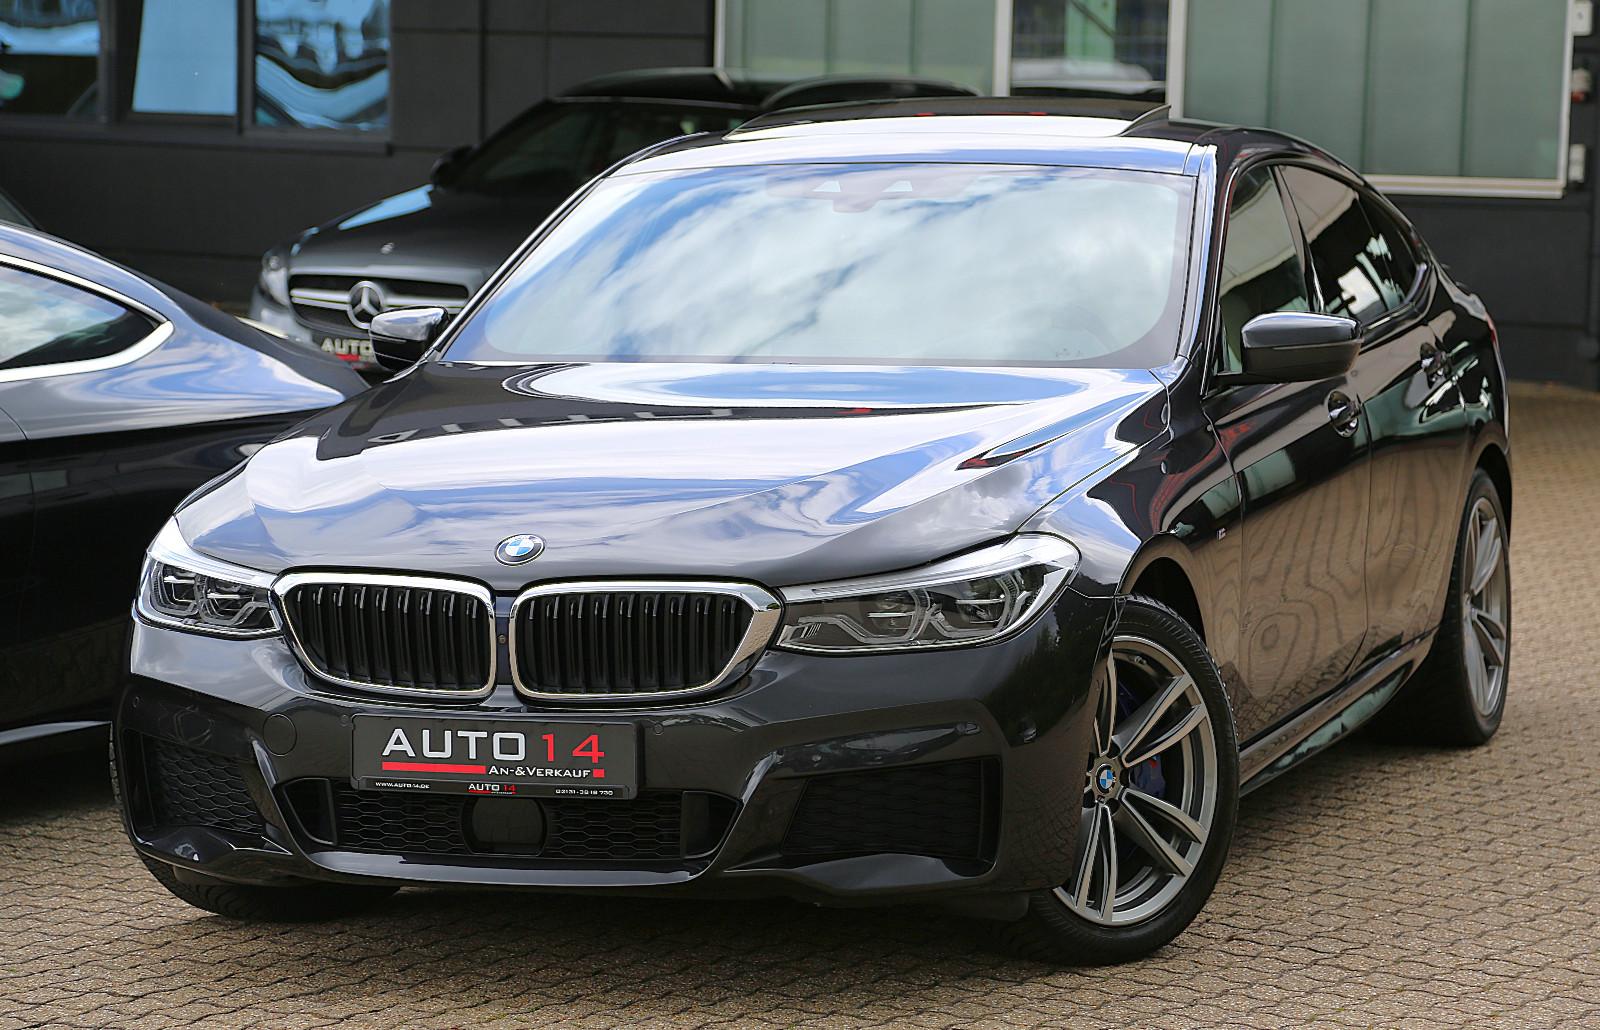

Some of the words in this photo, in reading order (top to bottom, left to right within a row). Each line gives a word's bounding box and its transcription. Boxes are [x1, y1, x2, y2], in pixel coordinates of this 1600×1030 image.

[382, 728, 526, 761] AUTO
[542, 733, 605, 764] 14
[468, 783, 500, 791] AUTO
[503, 784, 517, 792] 14
